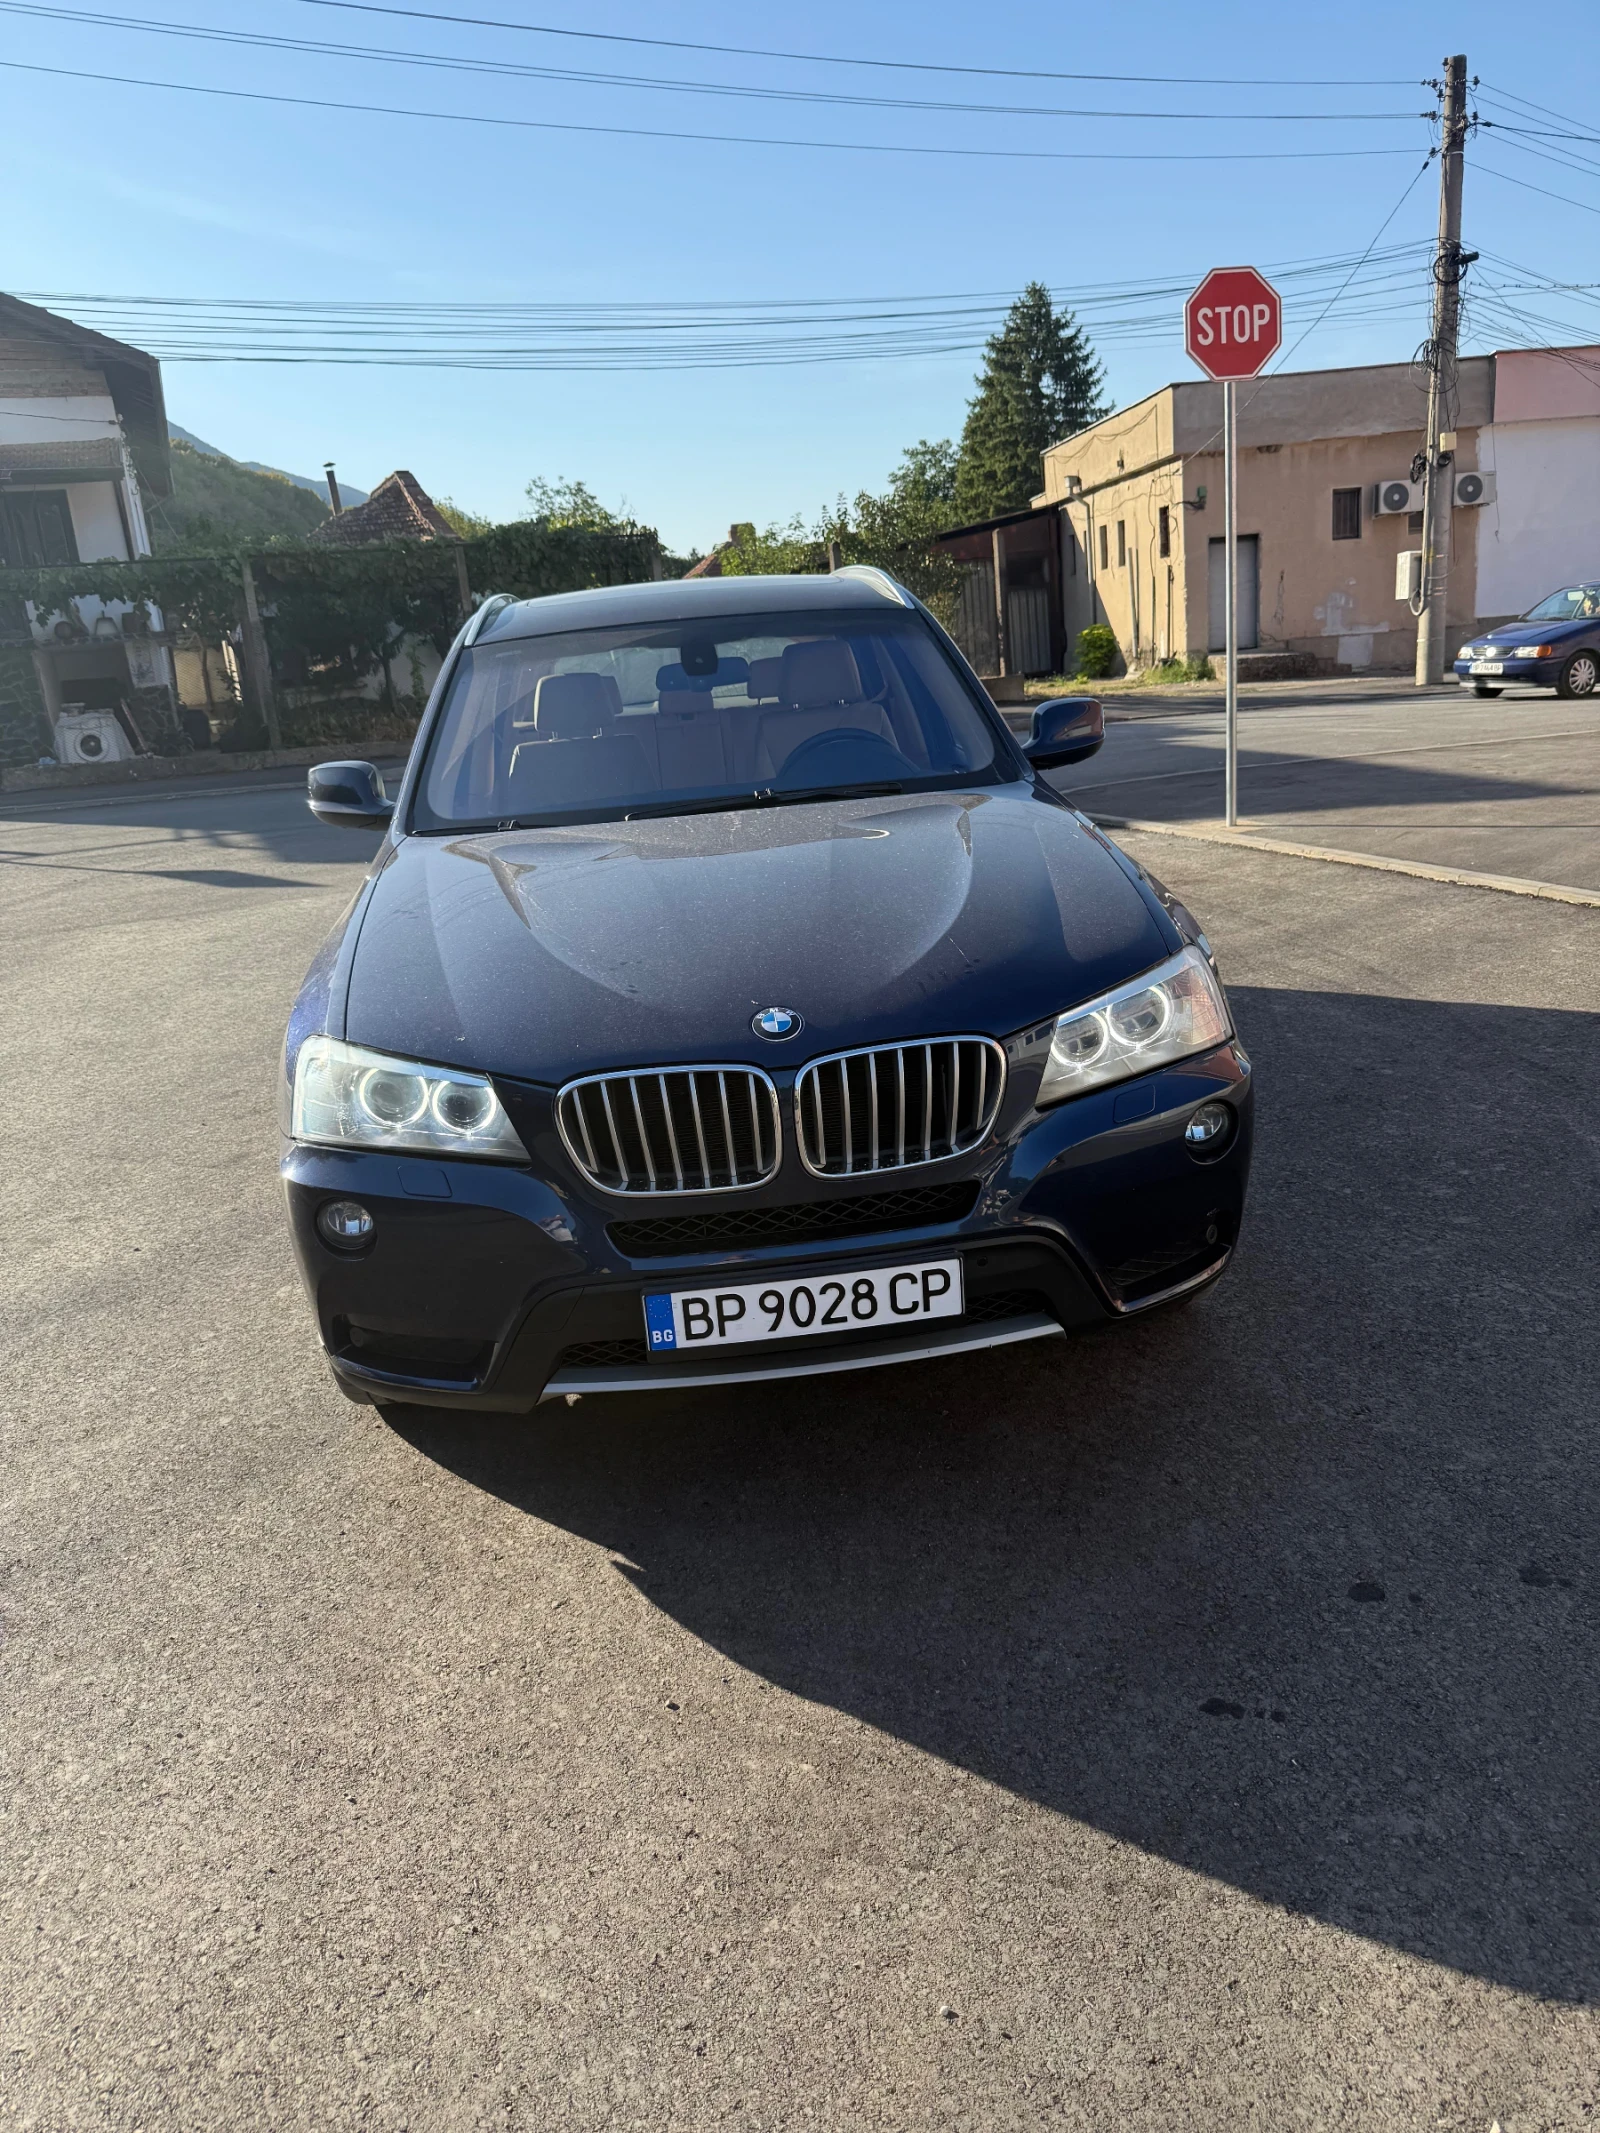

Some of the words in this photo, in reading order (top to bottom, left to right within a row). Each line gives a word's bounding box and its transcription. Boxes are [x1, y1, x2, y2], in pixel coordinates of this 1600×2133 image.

[1197, 304, 1270, 345] STOP
[681, 1293, 747, 1340] BP
[758, 1278, 878, 1332] 9028
[889, 1268, 951, 1315] CP
[652, 1329, 674, 1344] BG
